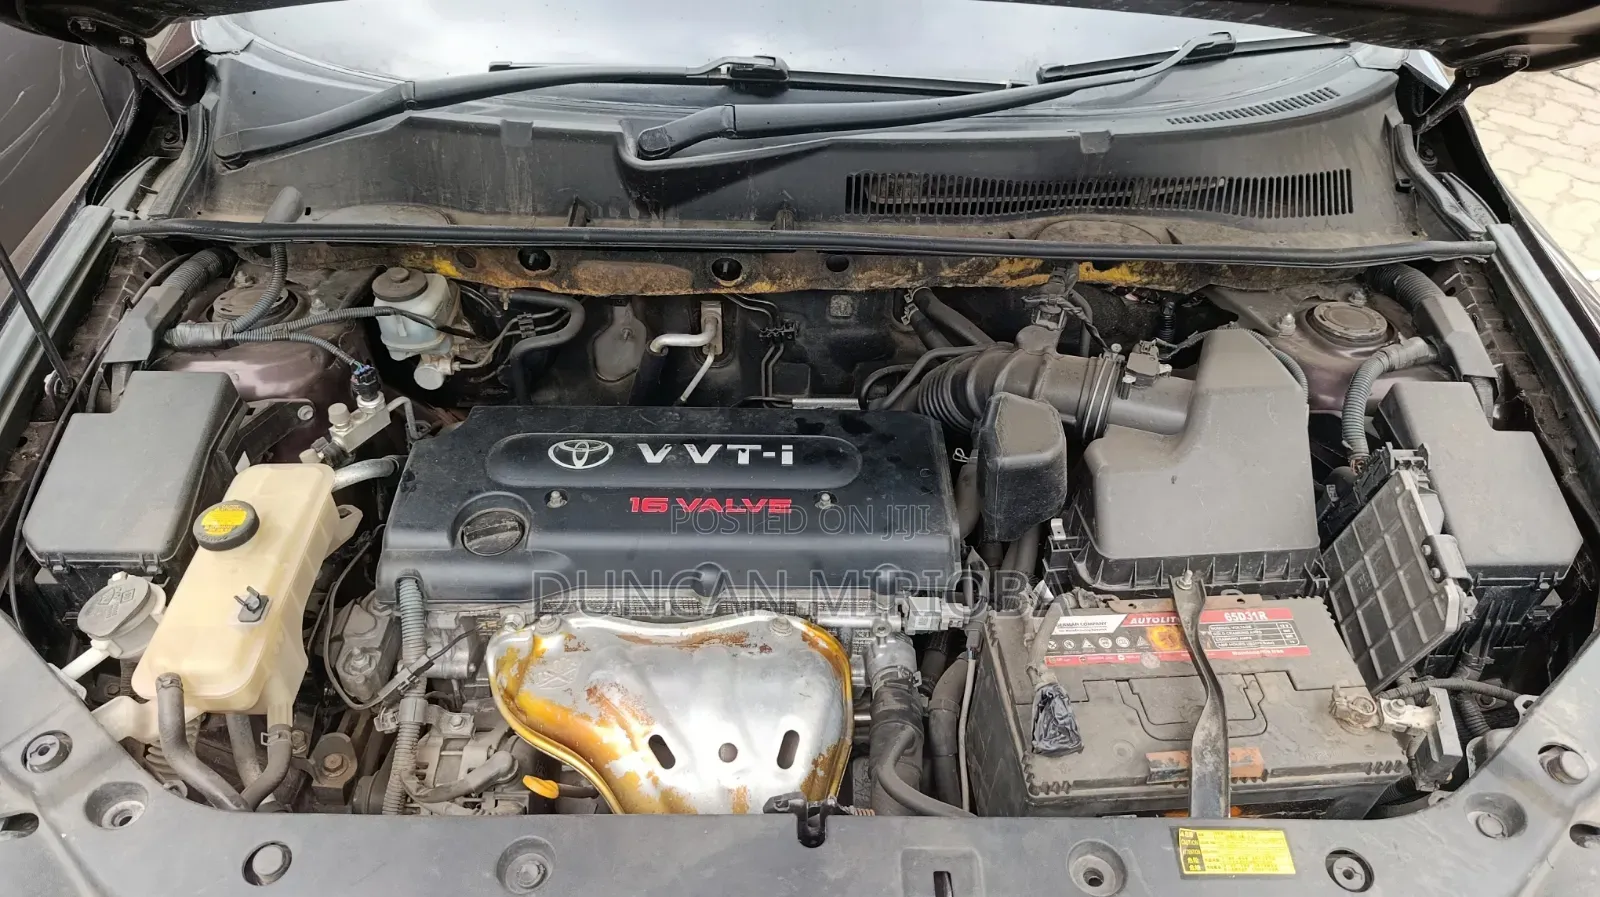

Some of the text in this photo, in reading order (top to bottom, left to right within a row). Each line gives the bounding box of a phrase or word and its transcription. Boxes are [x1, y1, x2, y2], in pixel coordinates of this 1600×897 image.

[637, 443, 793, 465] VVT-i
[630, 497, 793, 514] 16 VALVE
[1130, 616, 1182, 625] AUTOLIT
[1223, 611, 1269, 622] 65D31R
